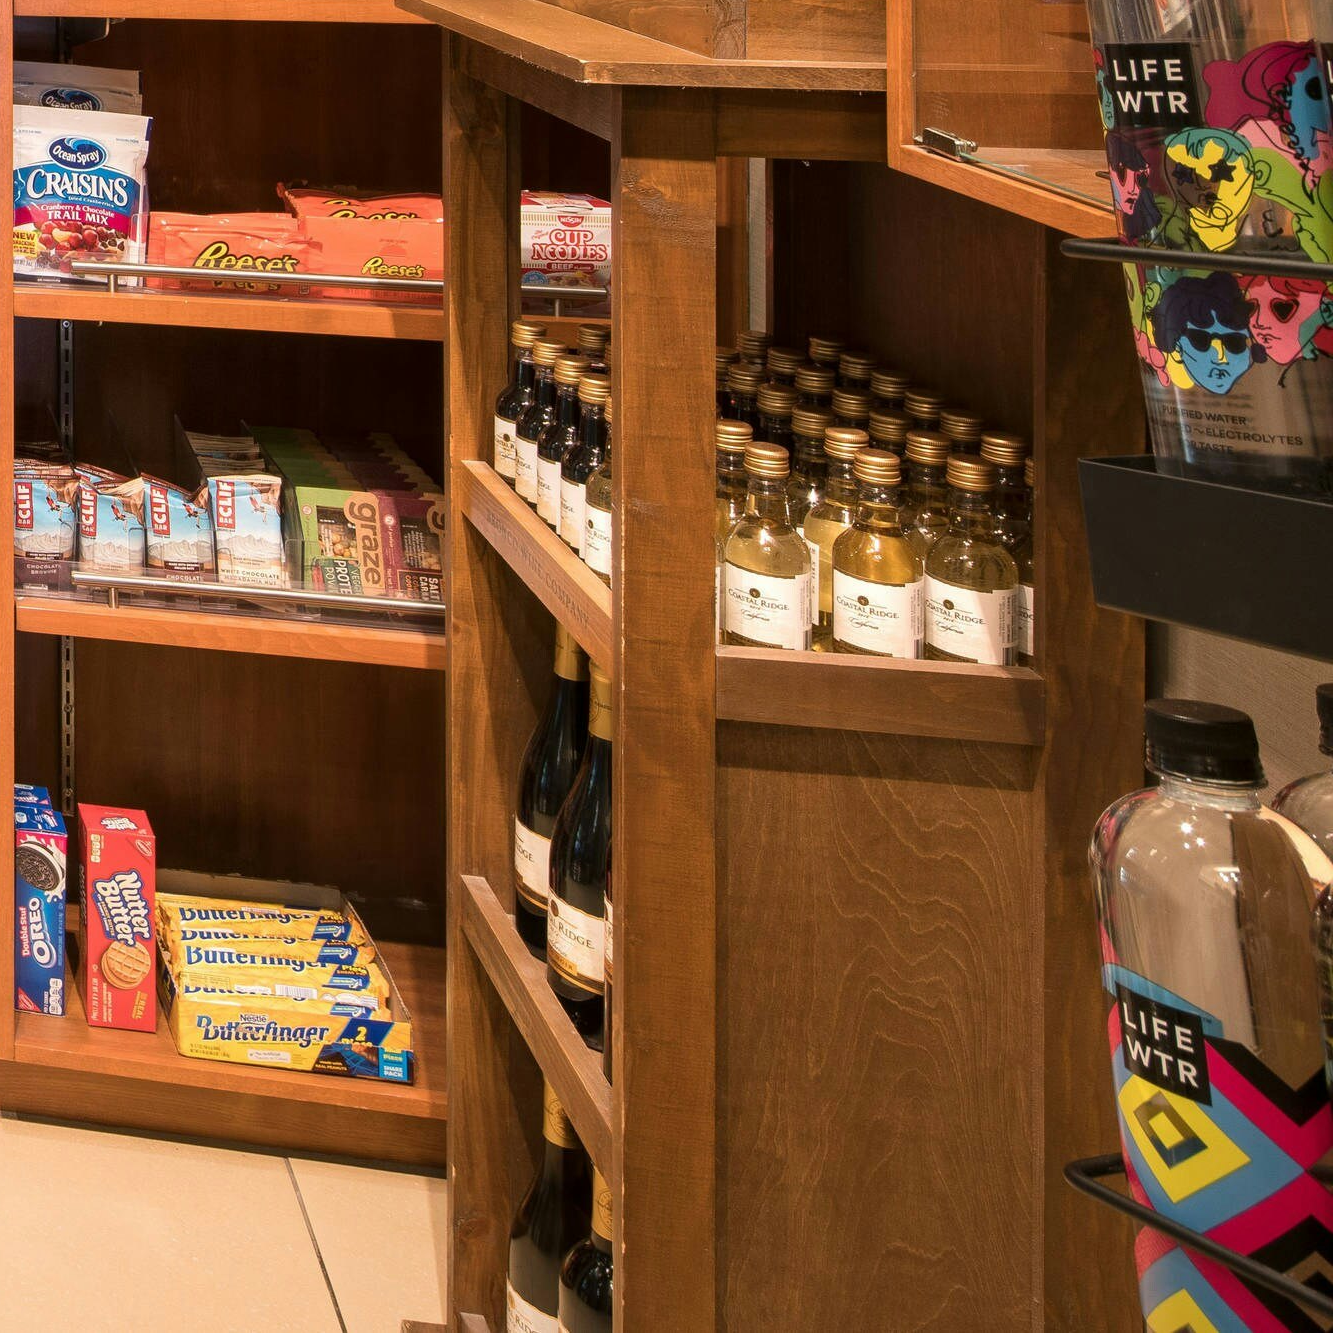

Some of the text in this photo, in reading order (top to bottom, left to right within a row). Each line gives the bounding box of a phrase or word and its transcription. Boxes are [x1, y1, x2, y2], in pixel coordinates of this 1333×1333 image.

[1113, 59, 1184, 83] LIFE
[1115, 90, 1190, 115] WTR
[52, 145, 100, 163] Ocean Spray
[26, 169, 129, 206] CRAISINS
[41, 203, 74, 213] Cranberry
[82, 206, 114, 218] Chocolate
[46, 211, 109, 225] TRAIL MIX
[559, 216, 583, 225] NISSIN
[548, 229, 592, 246] CUP
[531, 243, 608, 261] NOODLES
[361, 257, 426, 280] Reese's
[551, 262, 574, 271] BEEF
[1205, 412, 1247, 427] WATER
[1205, 427, 1304, 446] ELECTROLYTES
[153, 487, 167, 520] CLIF
[155, 522, 168, 531] BAR
[348, 501, 381, 585] graze
[728, 588, 790, 611] COASTAL RIDGE
[836, 595, 900, 619] COASTAL RIDGE
[96, 880, 134, 946] Butter
[115, 871, 150, 939] Nutter
[28, 898, 51, 964] OREO
[356, 1027, 367, 1041] 2
[1122, 1002, 1195, 1054] LIFE
[1126, 1037, 1199, 1089] WTR
